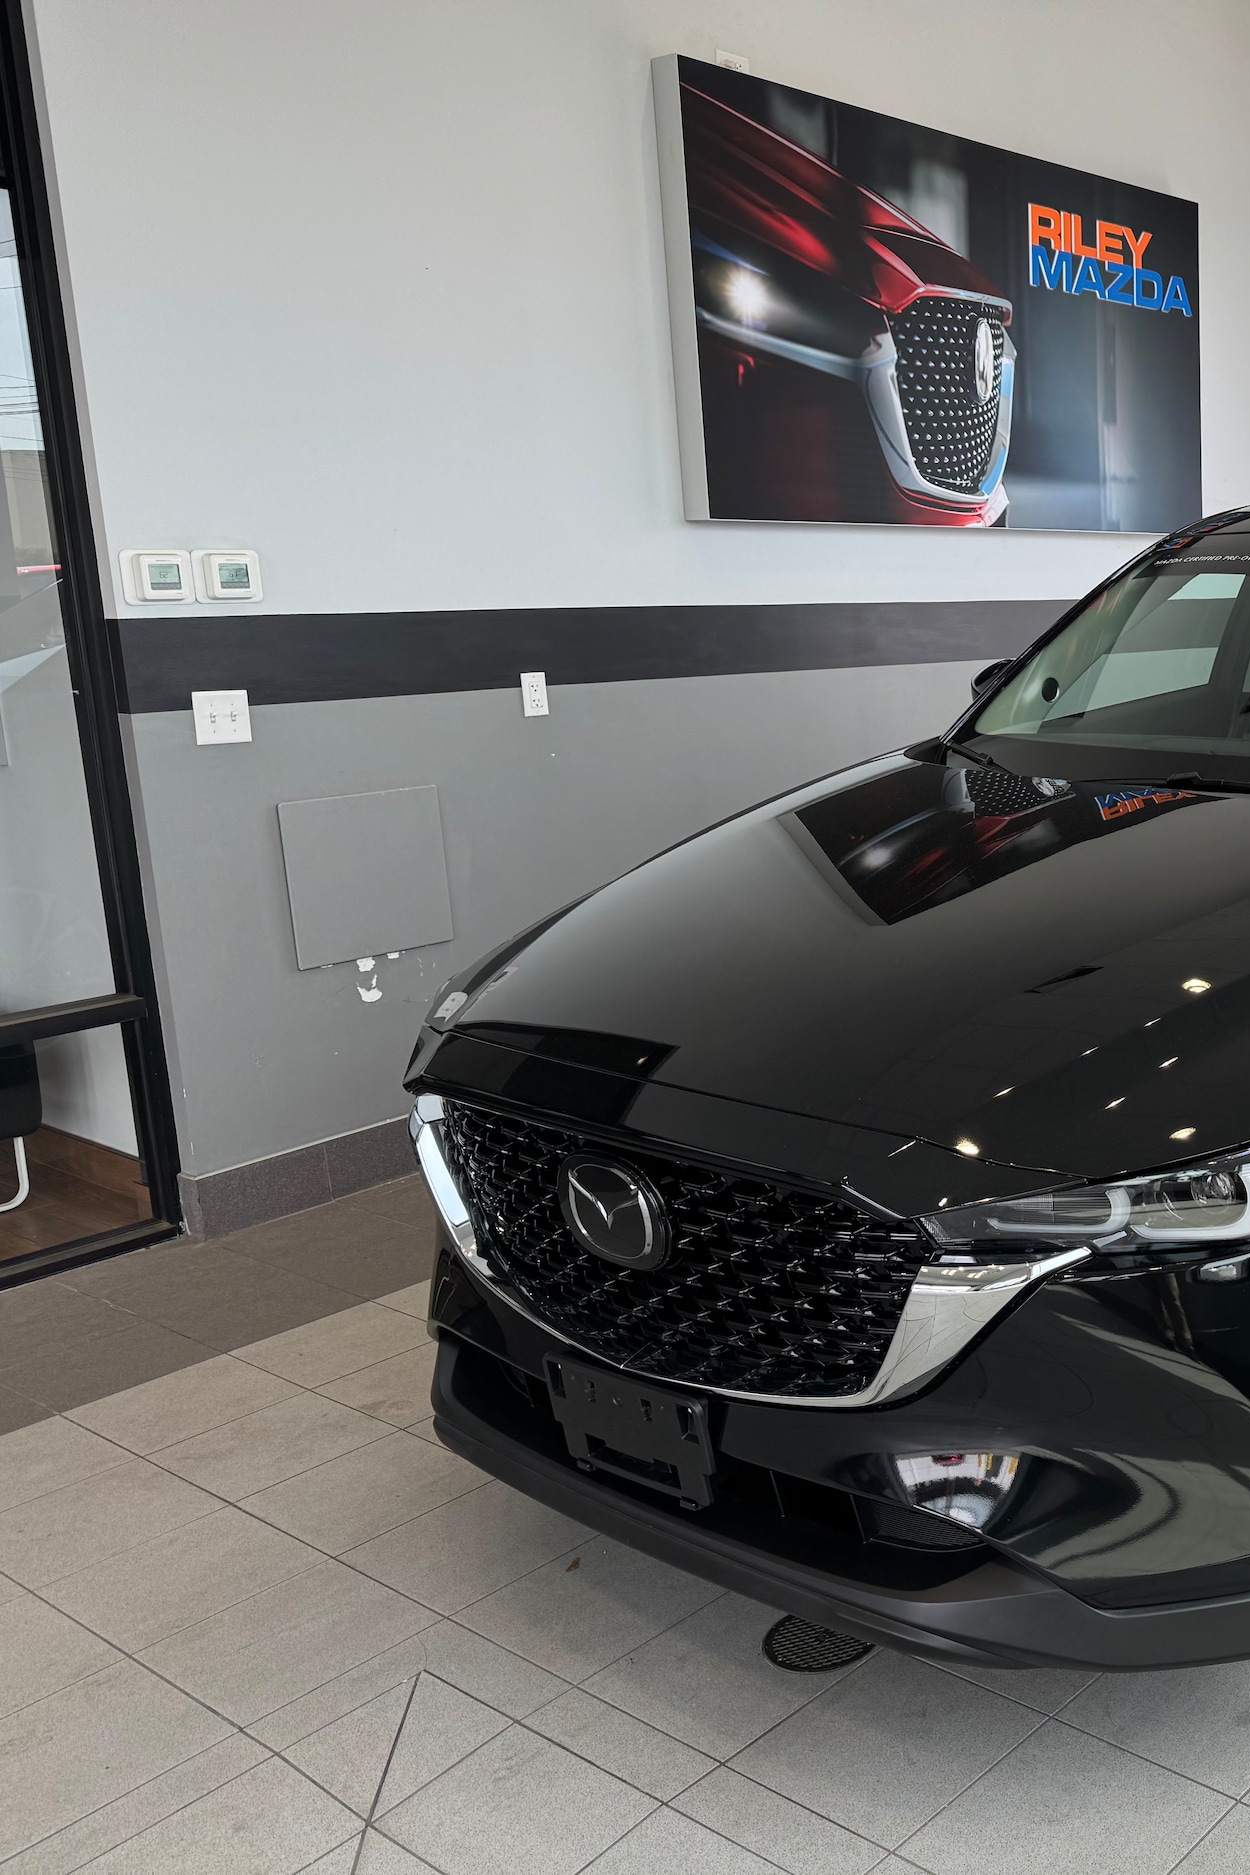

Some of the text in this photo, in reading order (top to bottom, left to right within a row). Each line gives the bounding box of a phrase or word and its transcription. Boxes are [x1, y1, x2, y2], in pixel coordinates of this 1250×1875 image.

[1028, 203, 1153, 270] RILEY
[1029, 245, 1193, 318] MAZDA
[1183, 555, 1223, 563] CERTIFIED
